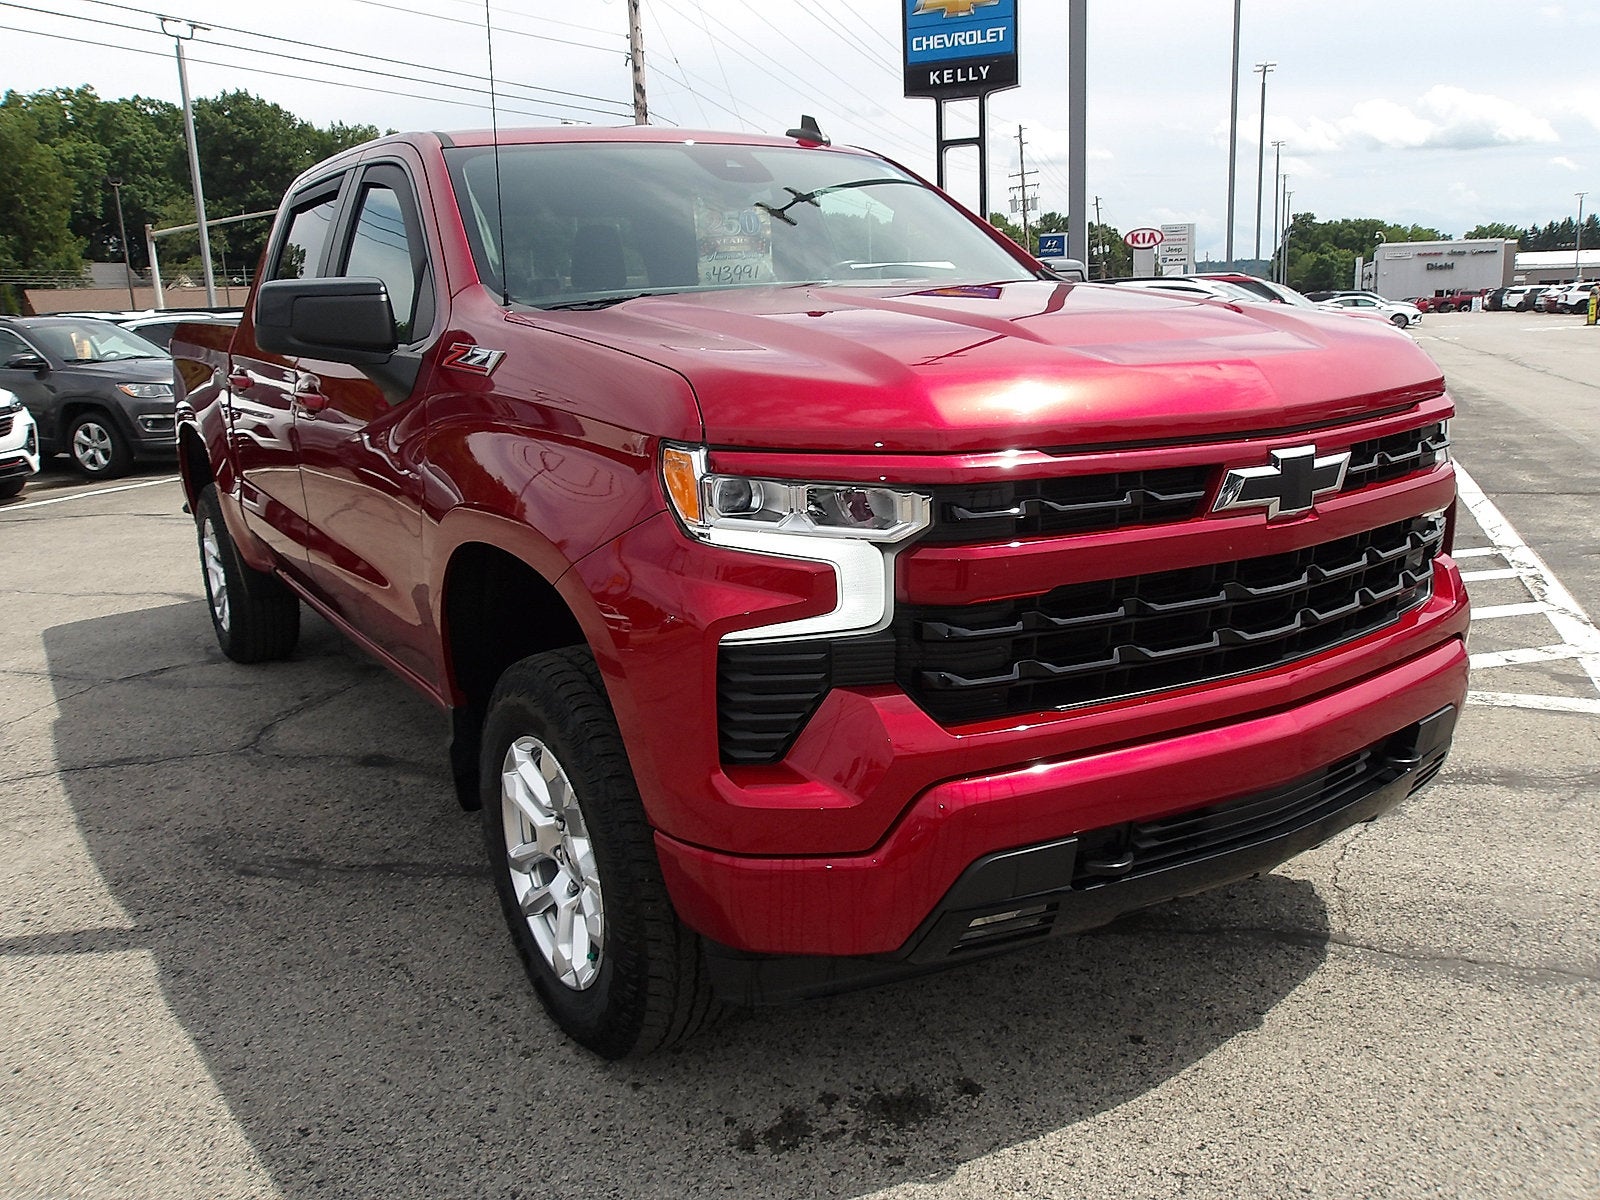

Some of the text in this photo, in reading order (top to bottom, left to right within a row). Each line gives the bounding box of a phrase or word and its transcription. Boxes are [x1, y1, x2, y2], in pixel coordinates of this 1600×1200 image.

[912, 26, 1006, 51] CHEVROLET
[929, 65, 990, 85] KELLY
[705, 208, 761, 236] 250
[1131, 232, 1158, 245] KIA
[441, 342, 506, 376] Z71
